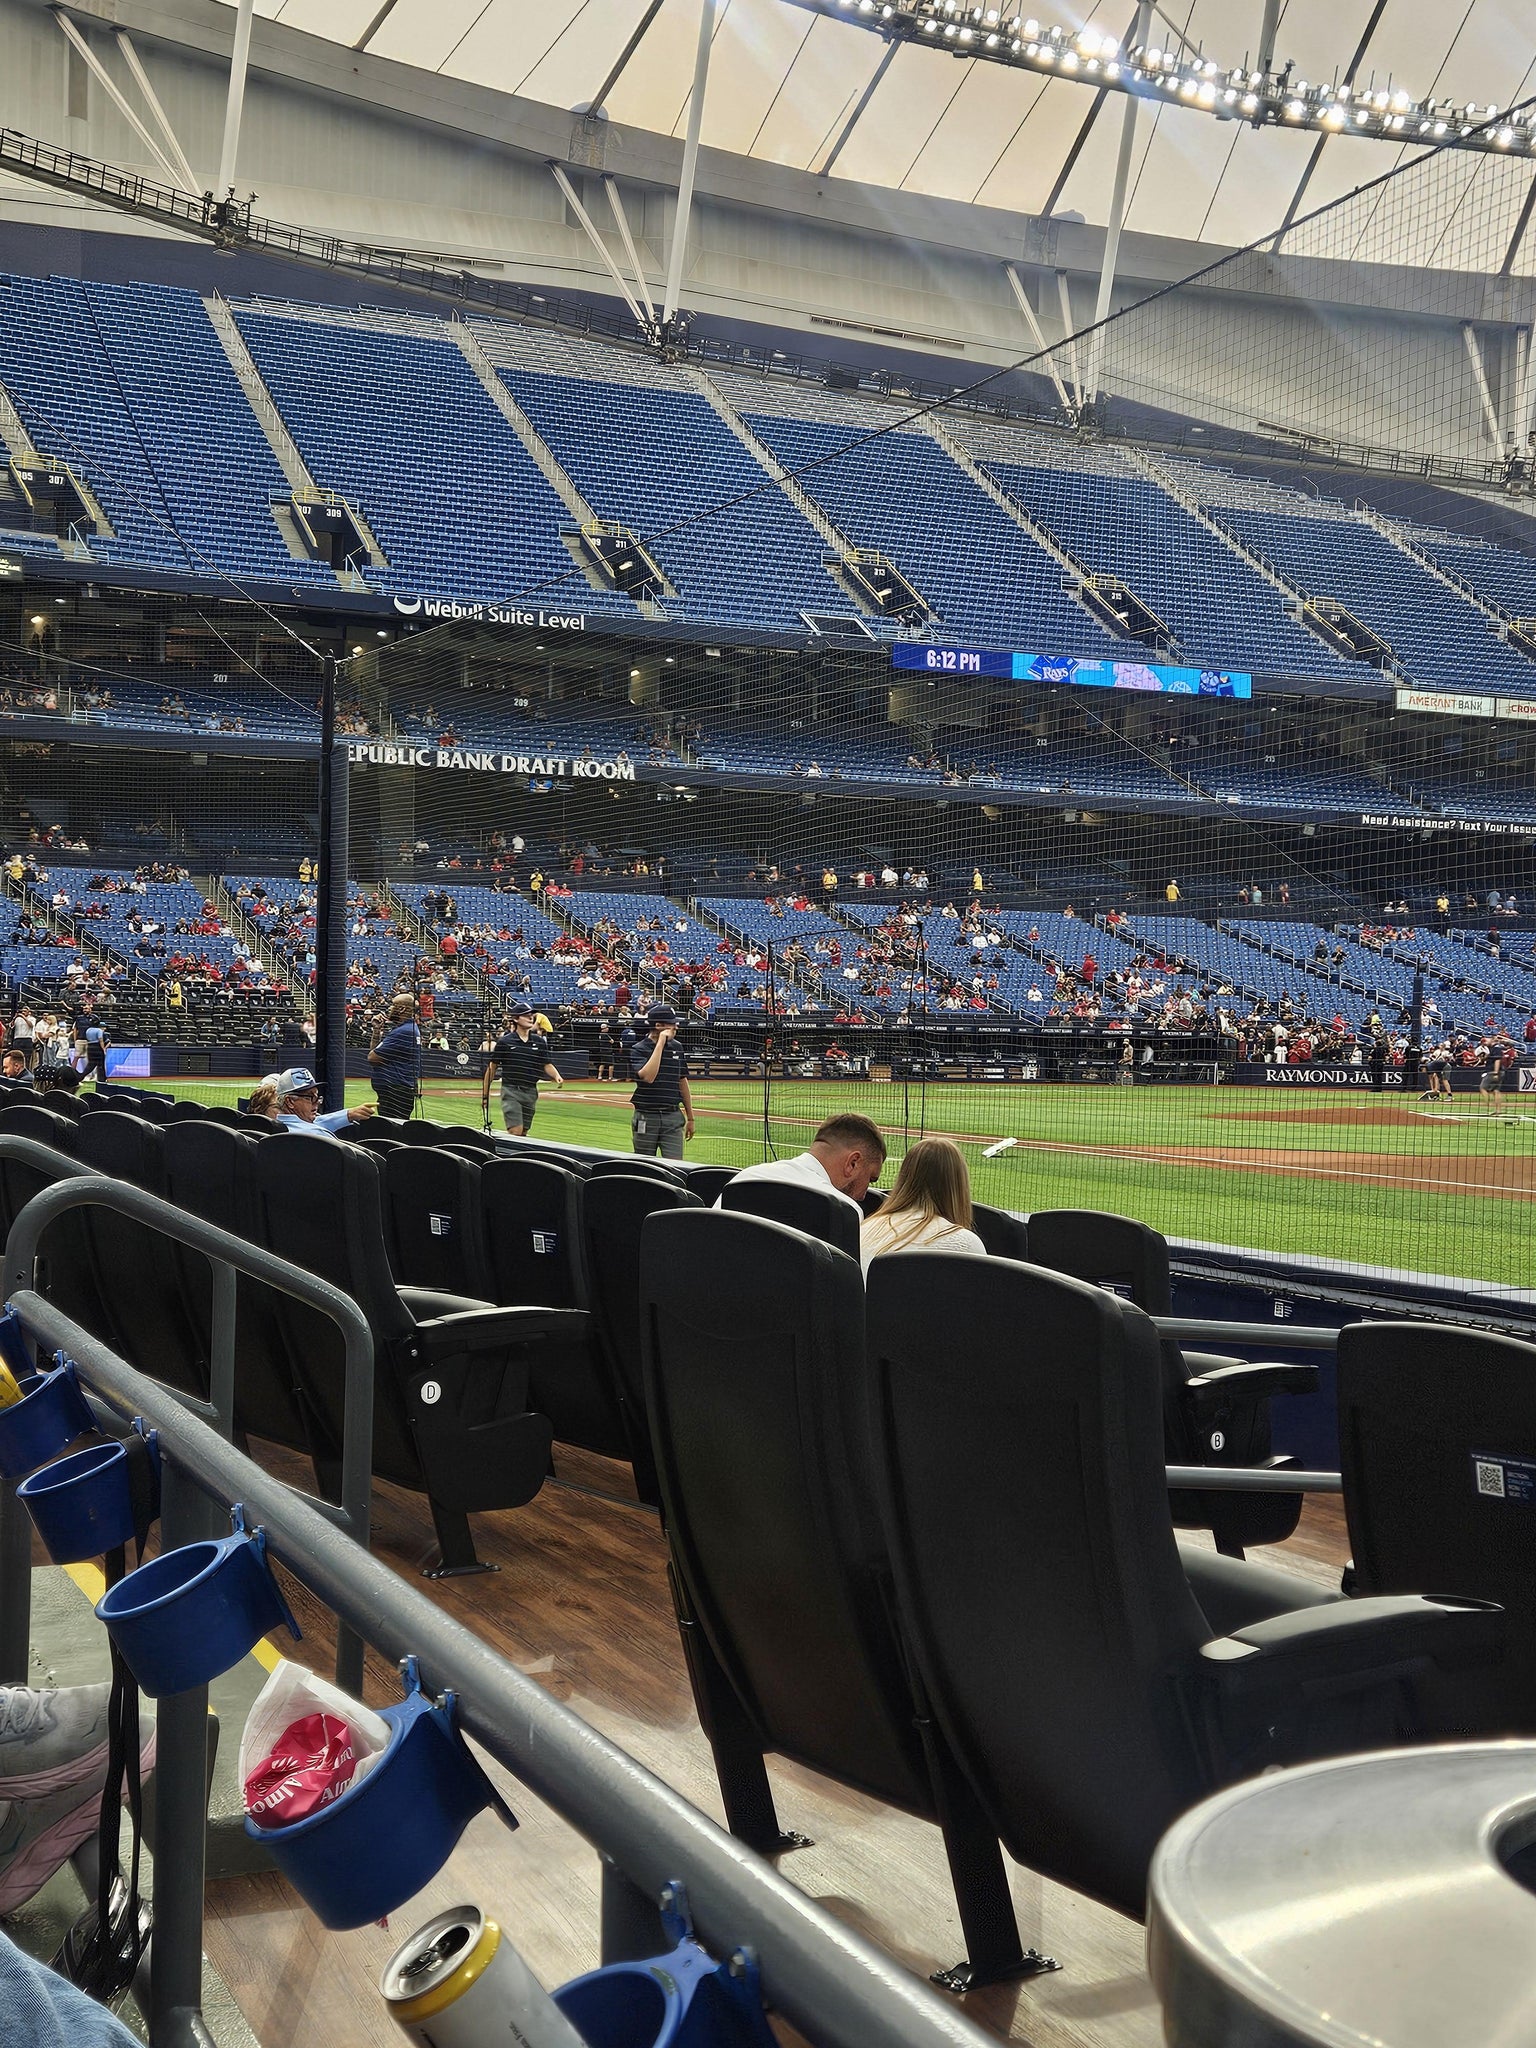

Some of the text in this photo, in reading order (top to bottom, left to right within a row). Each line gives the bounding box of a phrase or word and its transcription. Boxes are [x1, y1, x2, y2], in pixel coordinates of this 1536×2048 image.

[48, 475, 65, 485] 307
[326, 508, 342, 518] 309
[423, 599, 585, 631] Webull Suite Level
[926, 649, 980, 672] 6:12 PM
[213, 673, 228, 683] 207
[1408, 695, 1483, 711] AMERANT BANK
[348, 745, 637, 781] EPUBLIC BANK DRAFT ROOM
[1361, 814, 1389, 826] Need
[1391, 816, 1456, 829] Assistance?
[1458, 820, 1482, 831] Text
[1484, 822, 1508, 832] Your
[1265, 1068, 1403, 1085] RAYMOND JAES
